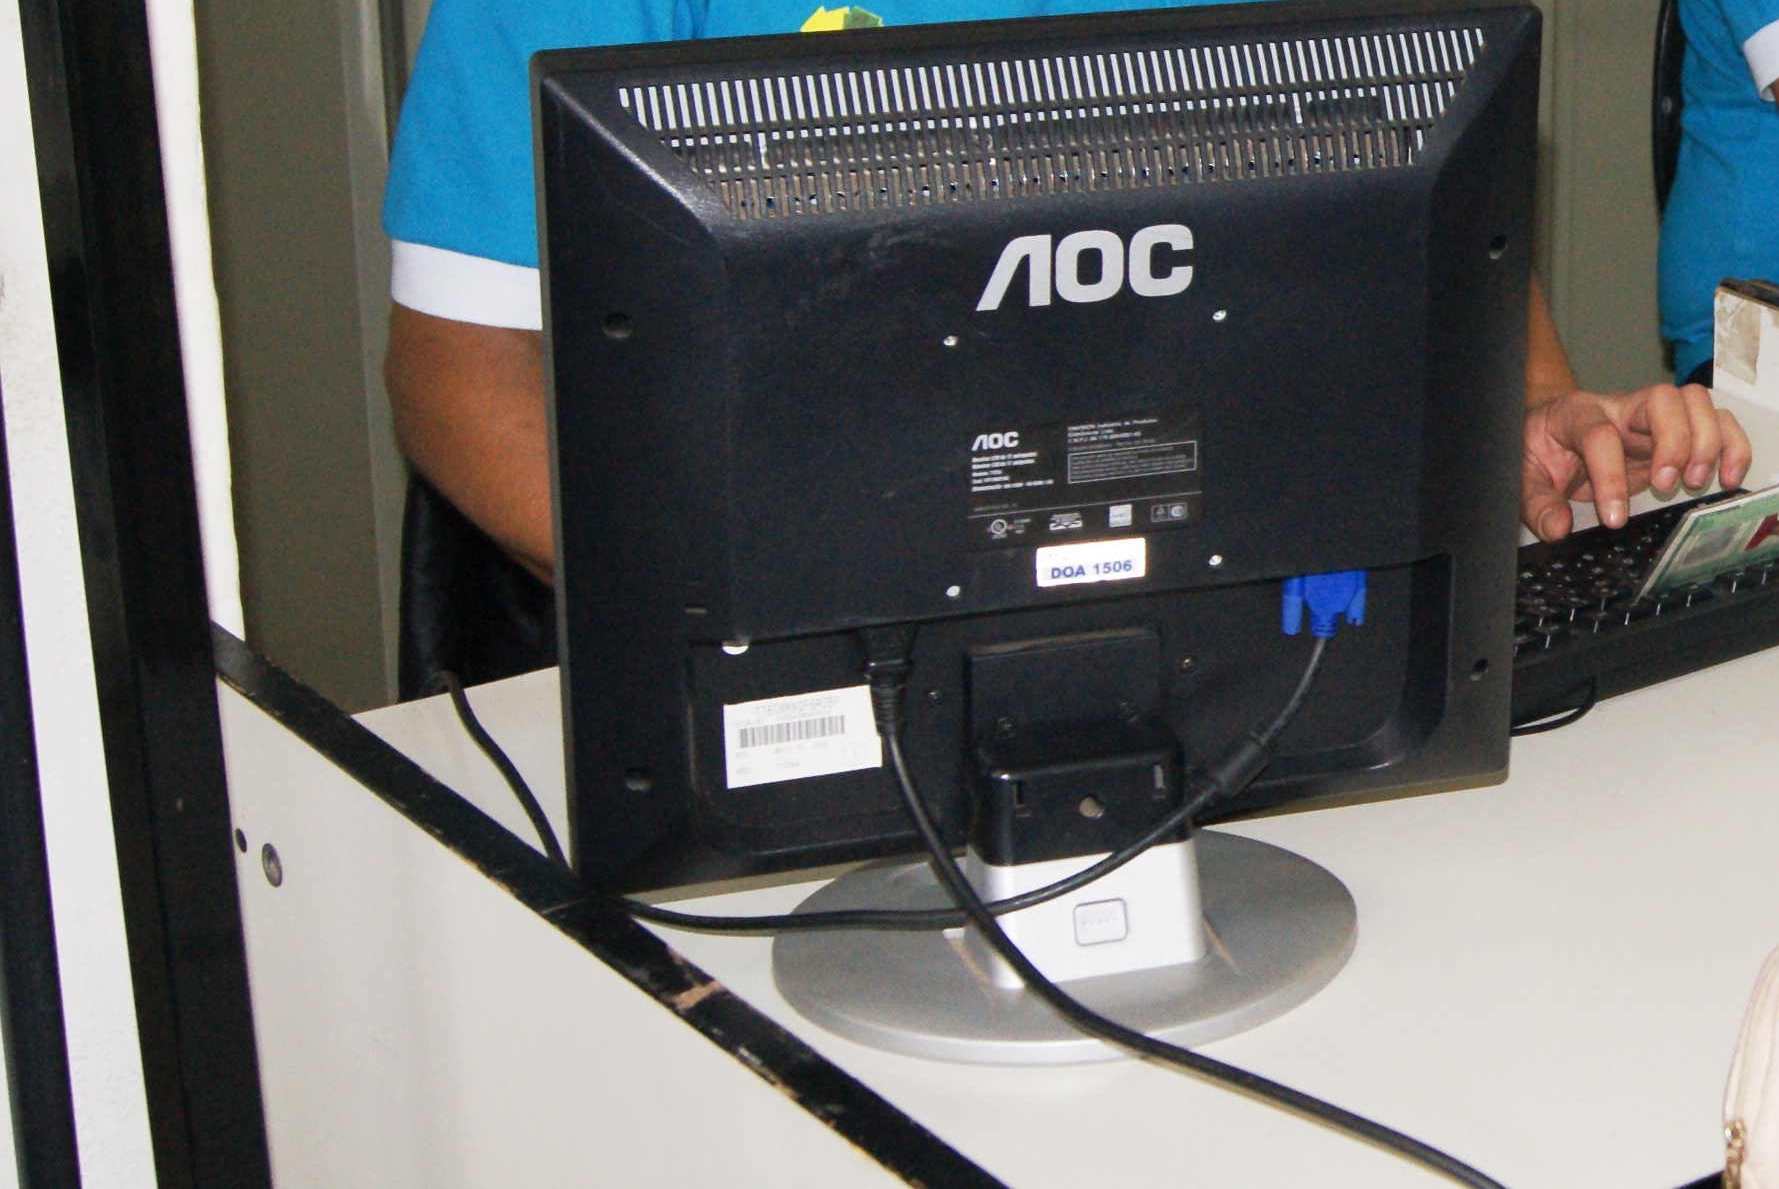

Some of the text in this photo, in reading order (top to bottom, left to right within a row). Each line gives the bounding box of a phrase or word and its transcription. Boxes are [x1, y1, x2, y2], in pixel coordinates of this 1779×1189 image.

[976, 224, 1194, 312] AOC
[971, 431, 1019, 451] AOC
[1051, 560, 1132, 579] DOA 1506
